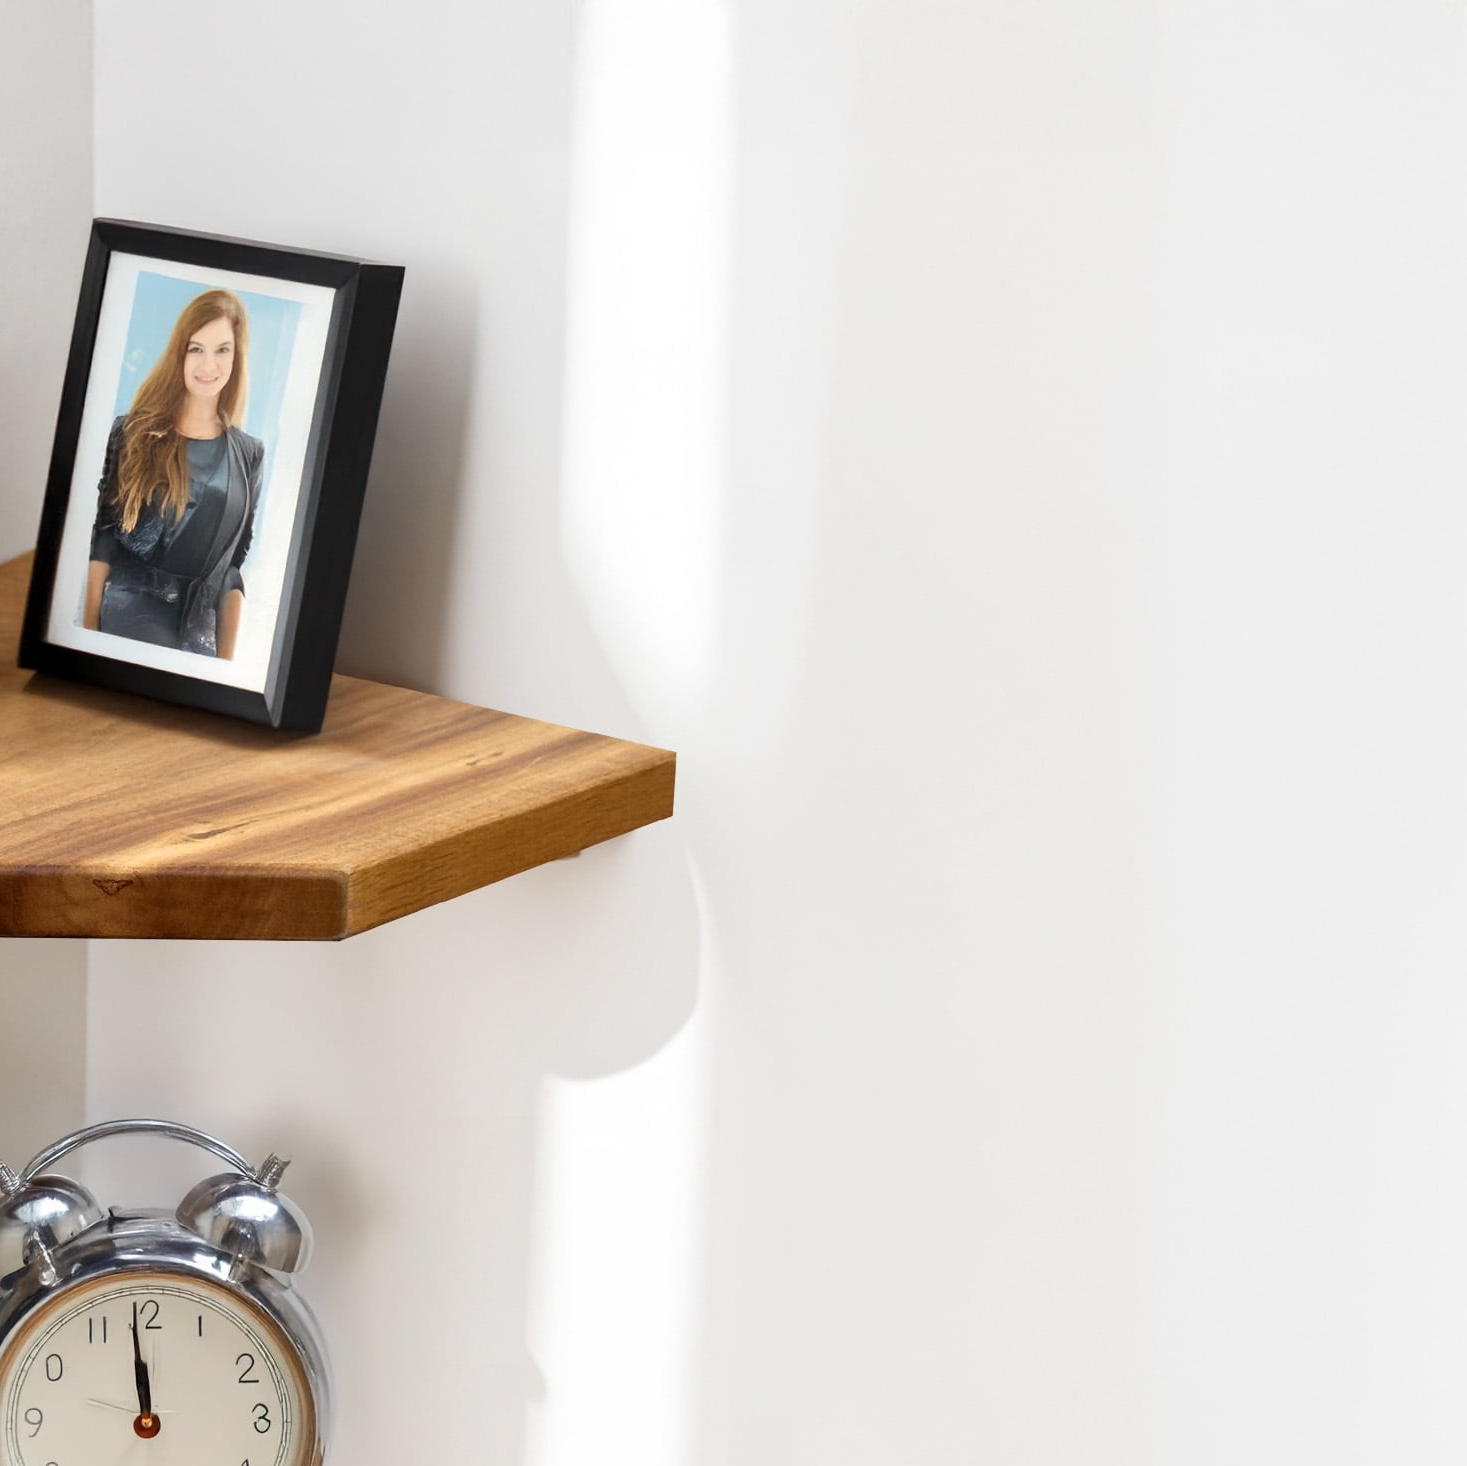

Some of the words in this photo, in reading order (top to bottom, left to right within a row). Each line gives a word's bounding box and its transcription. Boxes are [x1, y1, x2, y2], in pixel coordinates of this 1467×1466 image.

[88, 1315, 108, 1344] 11
[234, 1352, 260, 1384] 2
[24, 1407, 44, 1438] 9
[251, 1402, 272, 1434] 3
